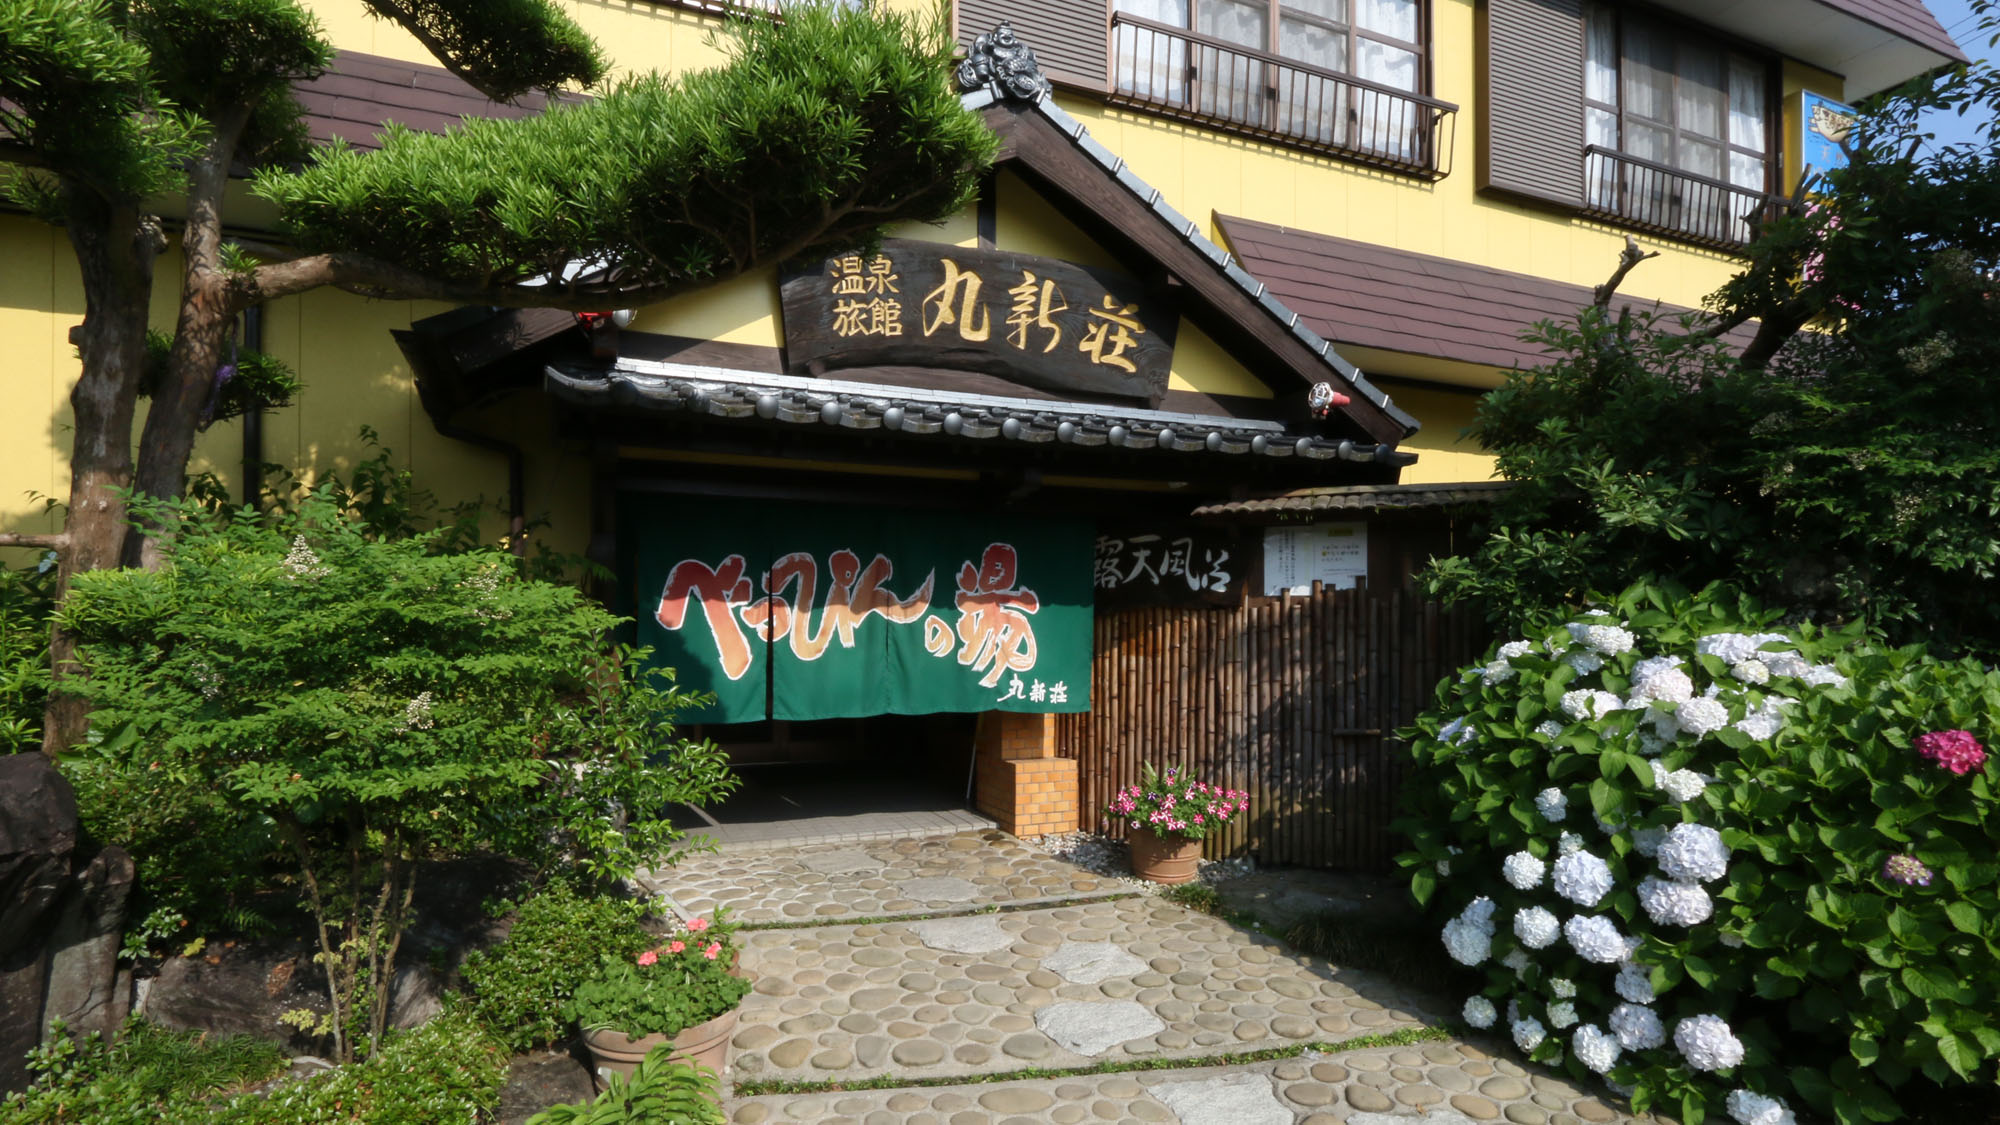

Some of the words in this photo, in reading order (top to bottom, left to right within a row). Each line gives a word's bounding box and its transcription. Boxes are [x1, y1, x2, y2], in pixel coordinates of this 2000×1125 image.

[831, 254, 899, 295] 温泉
[830, 297, 903, 338] 旅館
[922, 258, 1147, 374] 丸新荘
[654, 542, 1040, 688] べっぴんの湯
[996, 673, 1068, 704] 丸新荘
